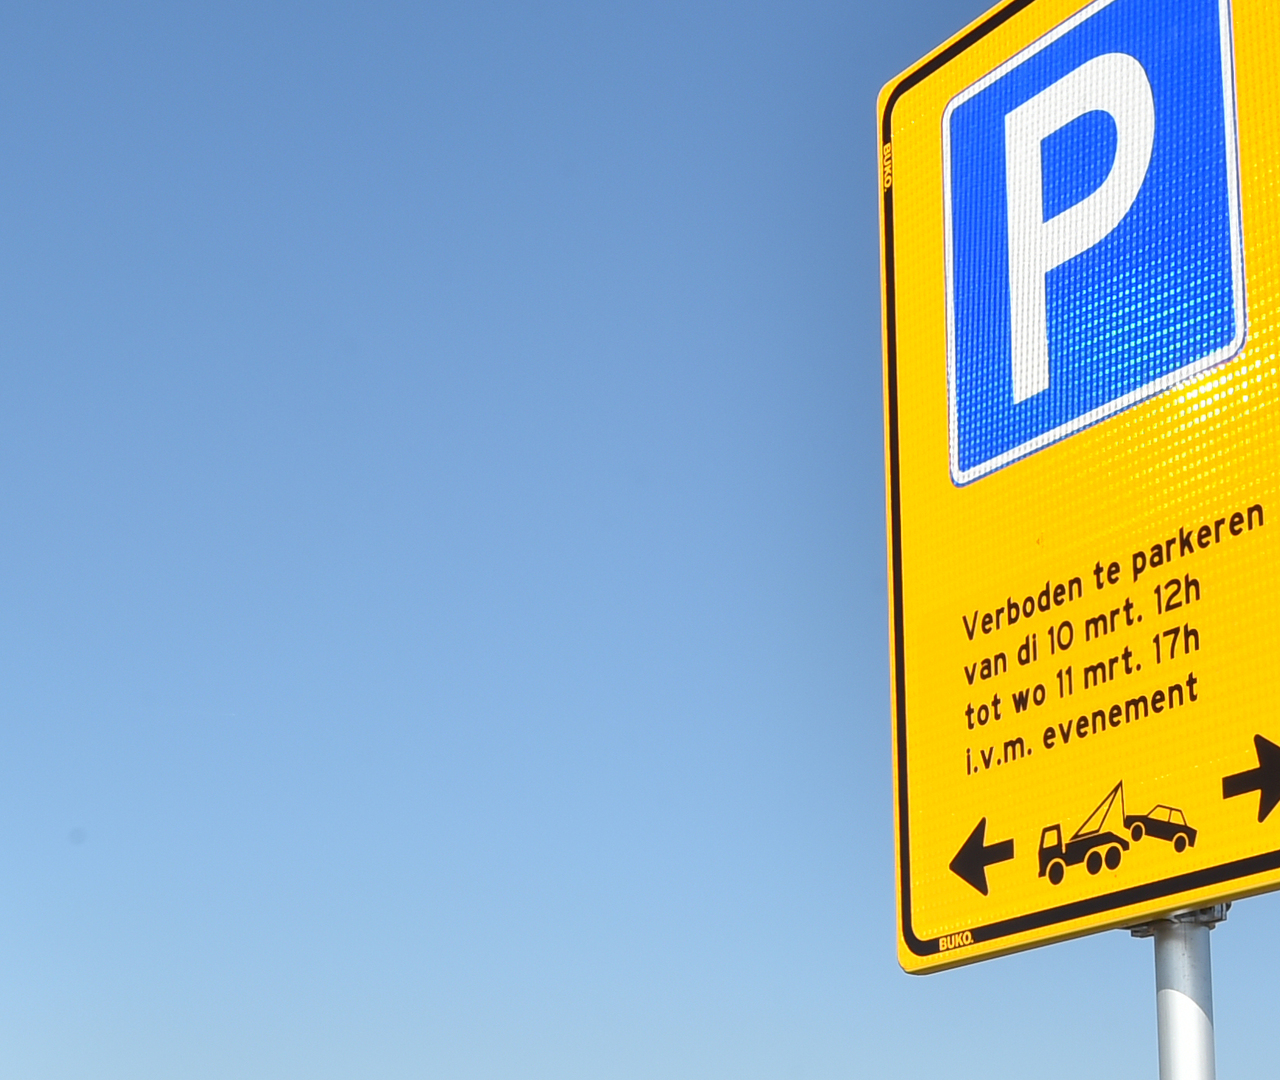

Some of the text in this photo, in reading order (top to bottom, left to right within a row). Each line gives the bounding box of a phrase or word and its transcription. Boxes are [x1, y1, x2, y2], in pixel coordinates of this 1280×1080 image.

[1004, 51, 1156, 405] P
[962, 503, 1265, 641] Verboden te parkeren
[964, 573, 1201, 686] van di 10 mrt. 12h
[965, 622, 1200, 730] tot wo 11 mrt. 17h
[966, 671, 1198, 775] i.v.m. evenement
